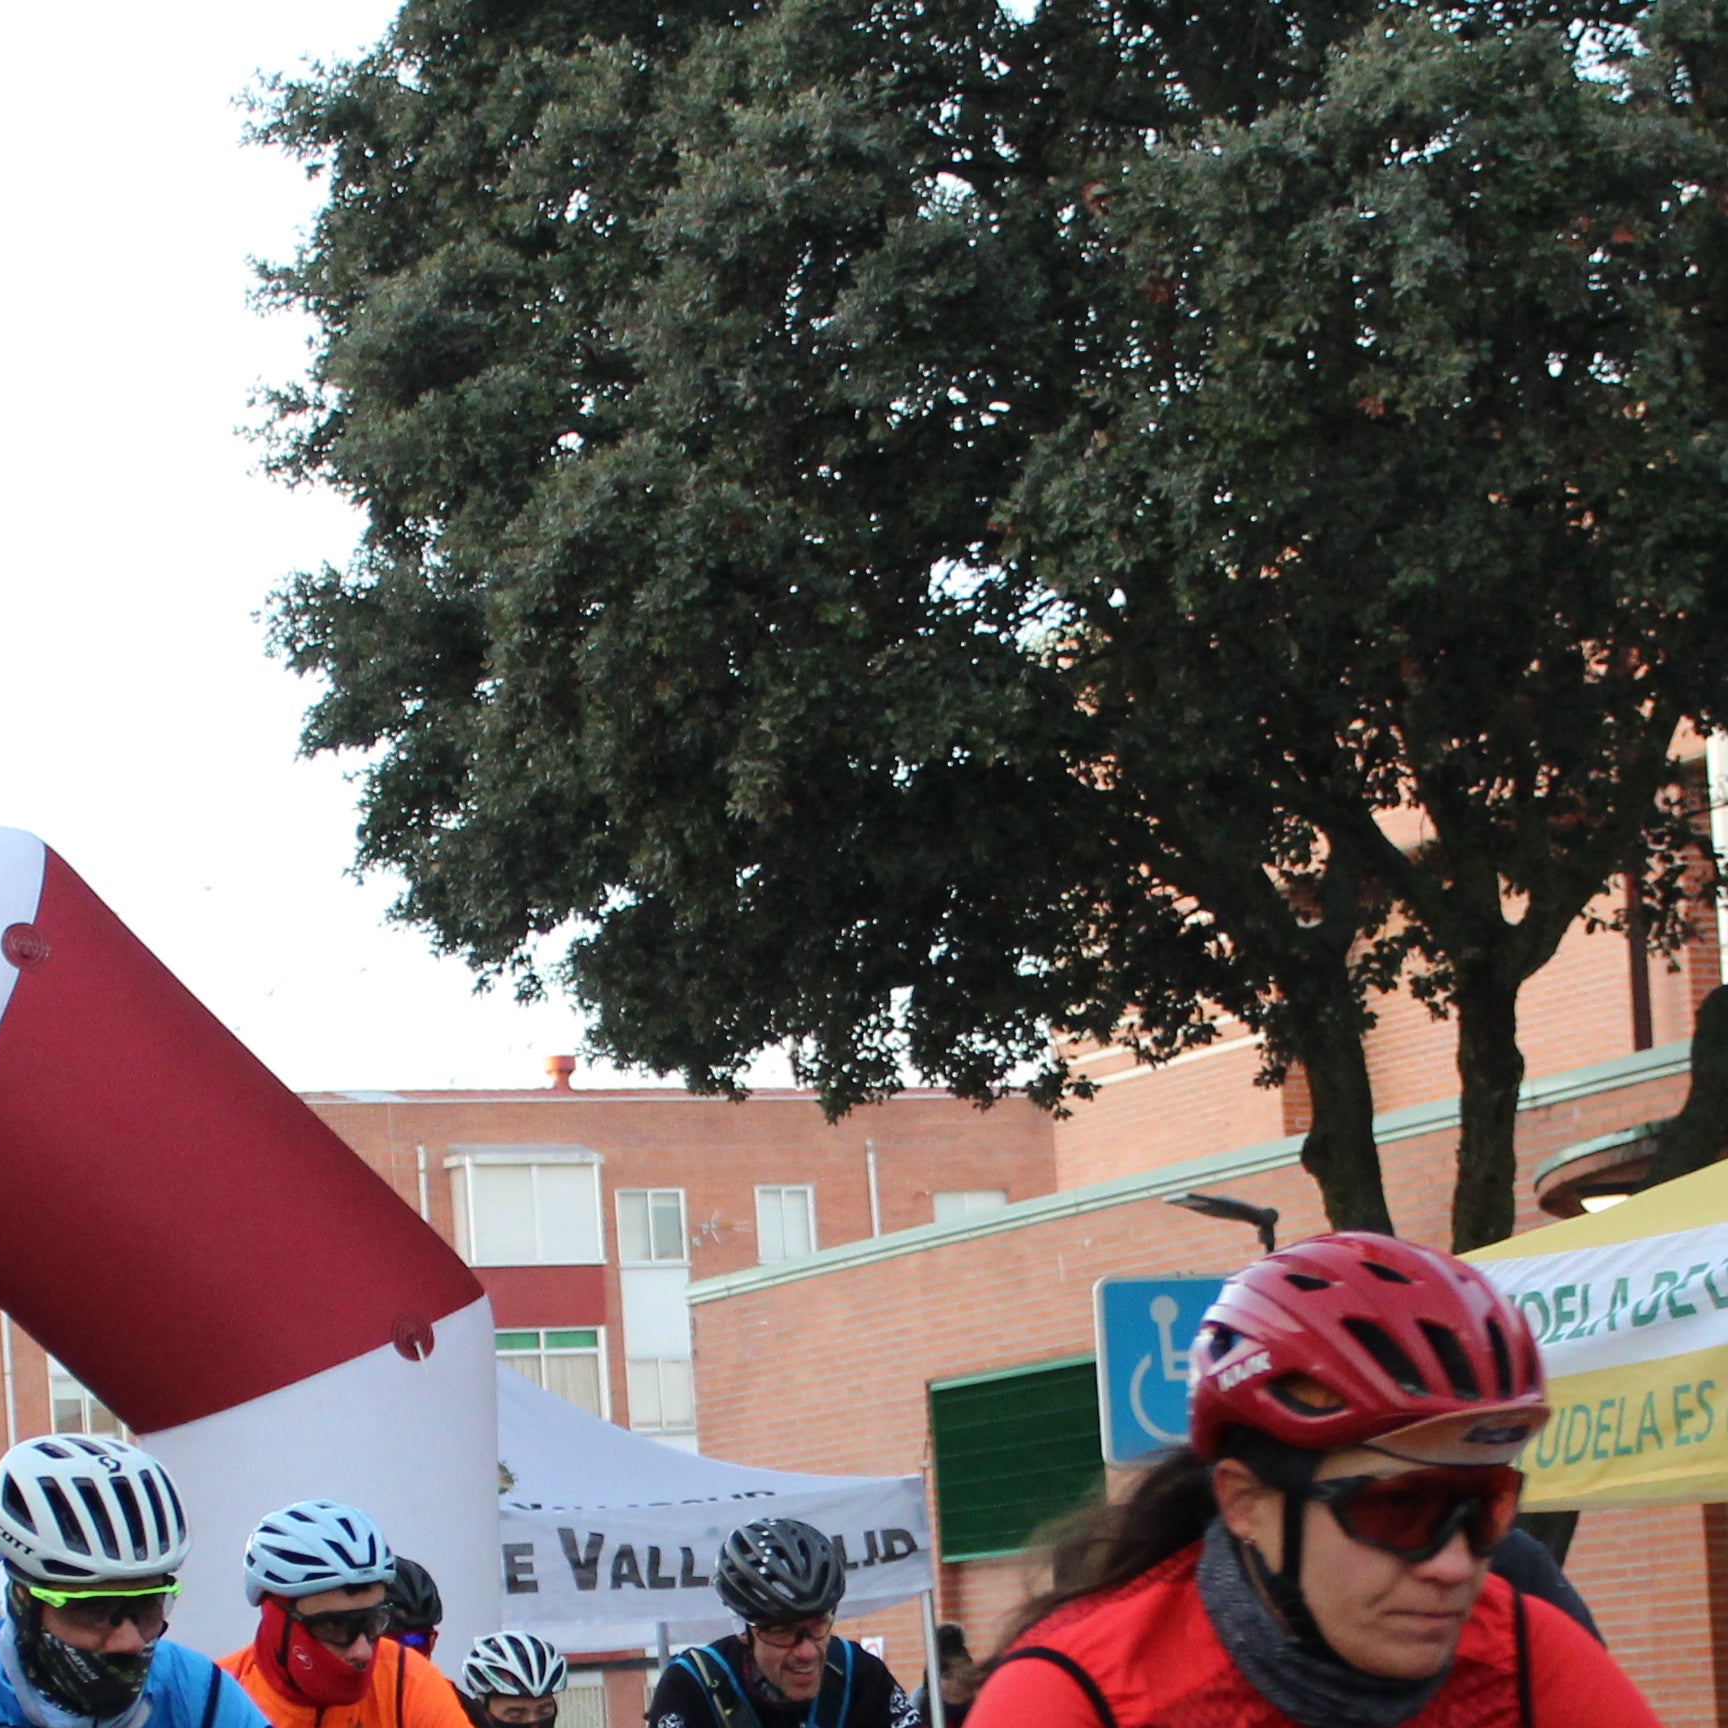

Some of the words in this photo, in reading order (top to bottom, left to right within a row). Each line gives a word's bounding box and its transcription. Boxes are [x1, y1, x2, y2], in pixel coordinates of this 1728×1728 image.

[1674, 1379, 1715, 1447] ES
[502, 1542, 540, 1595] E
[557, 1526, 920, 1592] VALLLID
